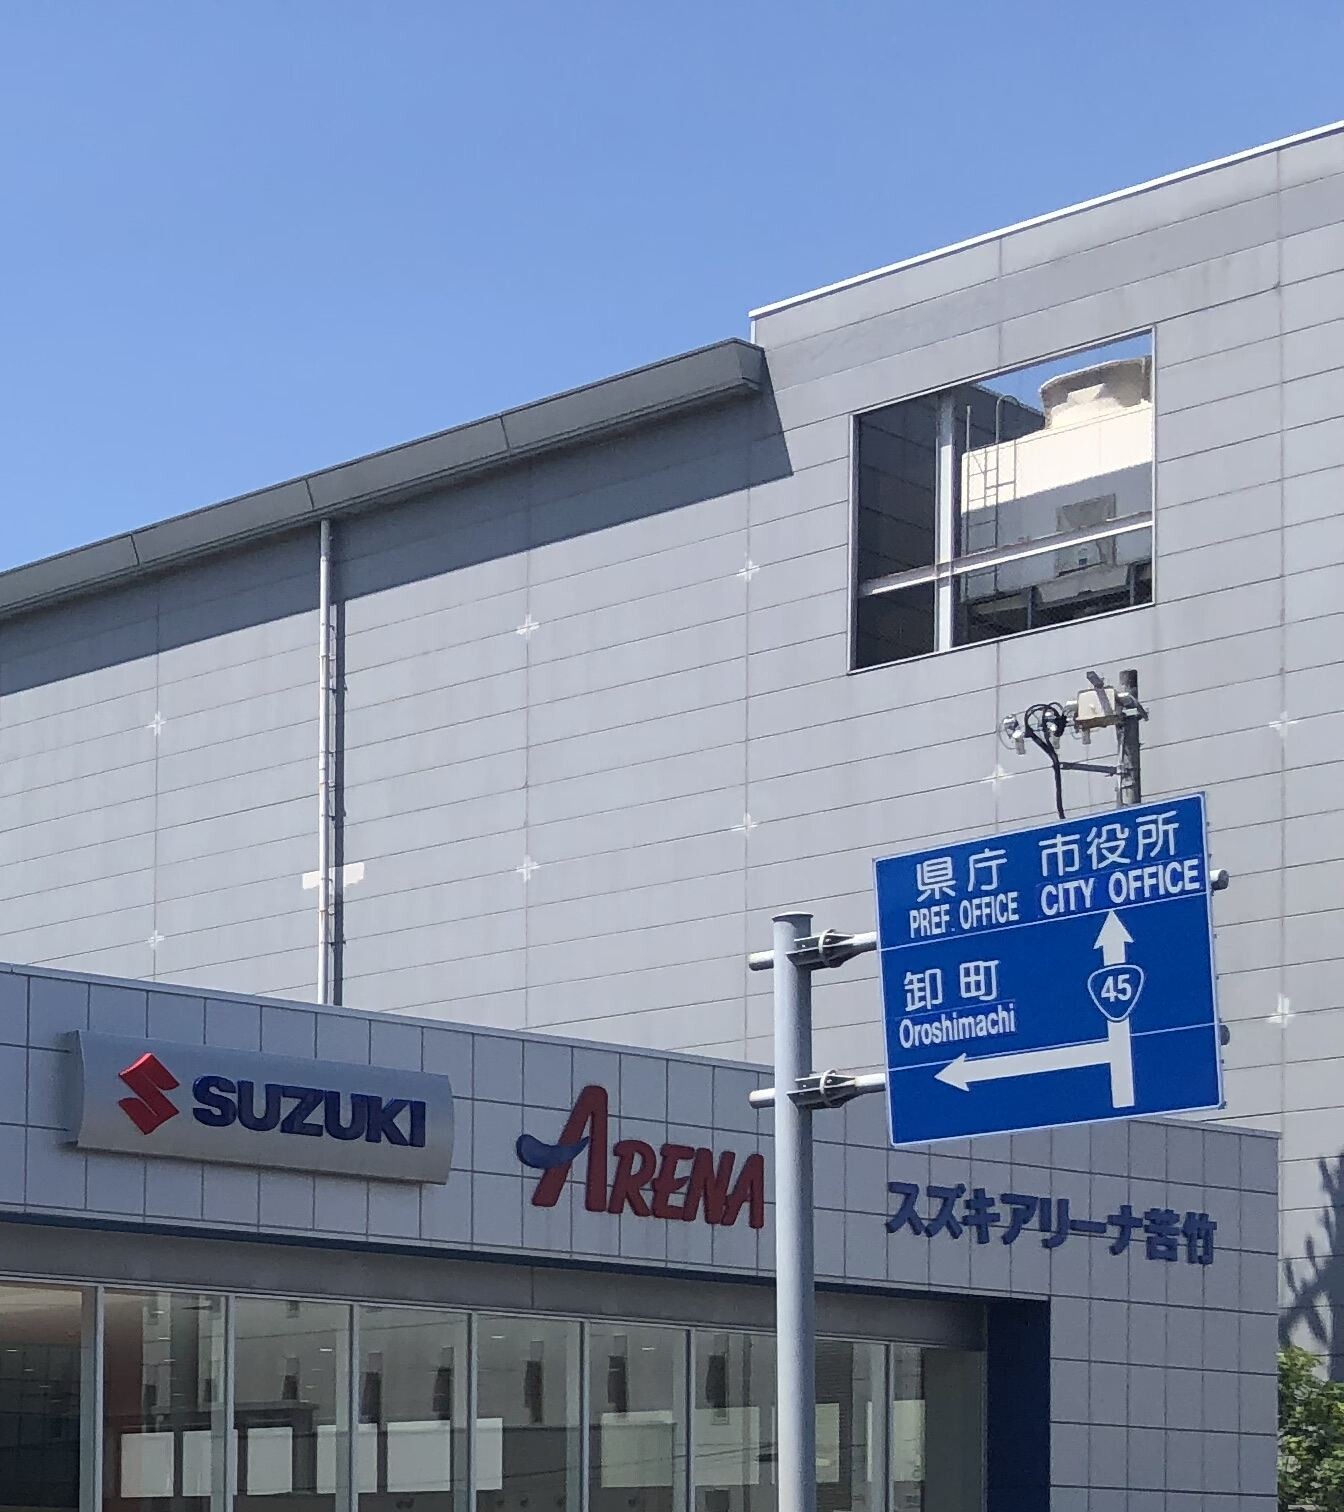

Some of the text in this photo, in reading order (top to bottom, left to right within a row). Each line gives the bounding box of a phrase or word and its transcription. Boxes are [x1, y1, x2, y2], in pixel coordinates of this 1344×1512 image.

[1038, 810, 1180, 878] 市役所
[916, 847, 1008, 903] 県庁
[1040, 858, 1201, 917] CITY OFFICE
[909, 891, 1020, 939] PREF. OFFICE
[903, 959, 1000, 1012] 卸町
[1100, 974, 1132, 1003] 45
[899, 1003, 1016, 1049] Oroshimachi
[192, 1075, 427, 1149] SUZUKI
[516, 1085, 765, 1230] ARENA
[885, 1181, 1218, 1265] スズキアリーナ苦竹
